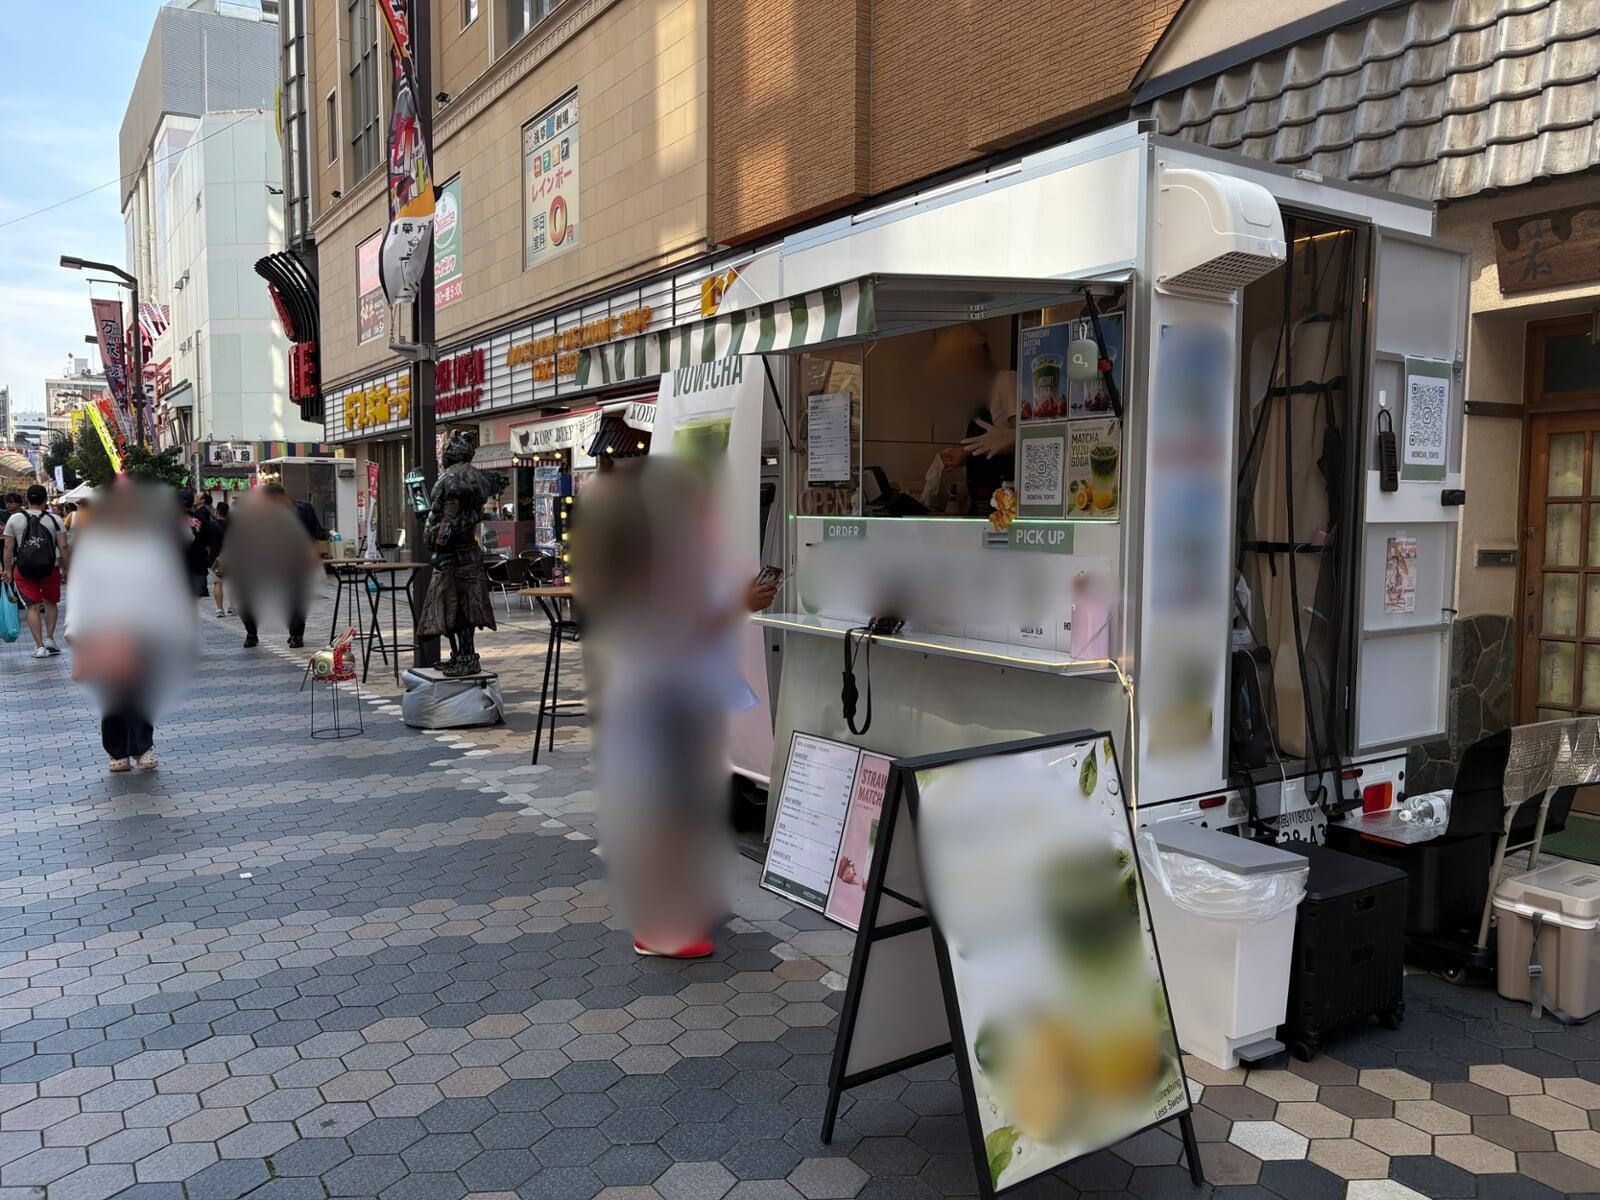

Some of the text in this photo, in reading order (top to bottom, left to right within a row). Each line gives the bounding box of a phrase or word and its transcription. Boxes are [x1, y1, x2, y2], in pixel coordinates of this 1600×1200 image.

[531, 166, 572, 203] レインボー
[1023, 347, 1037, 356] LATTE
[455, 348, 485, 388] OPEN
[555, 424, 573, 442] BEEF
[1071, 432, 1099, 444] MATCHA
[1071, 445, 1089, 455] YUZU
[1070, 457, 1088, 467] SODA
[801, 490, 851, 514] OPEN
[828, 525, 859, 537] ORDER
[1016, 529, 1065, 545] PICK UP
[1154, 1092, 1185, 1120] Less Sweet
